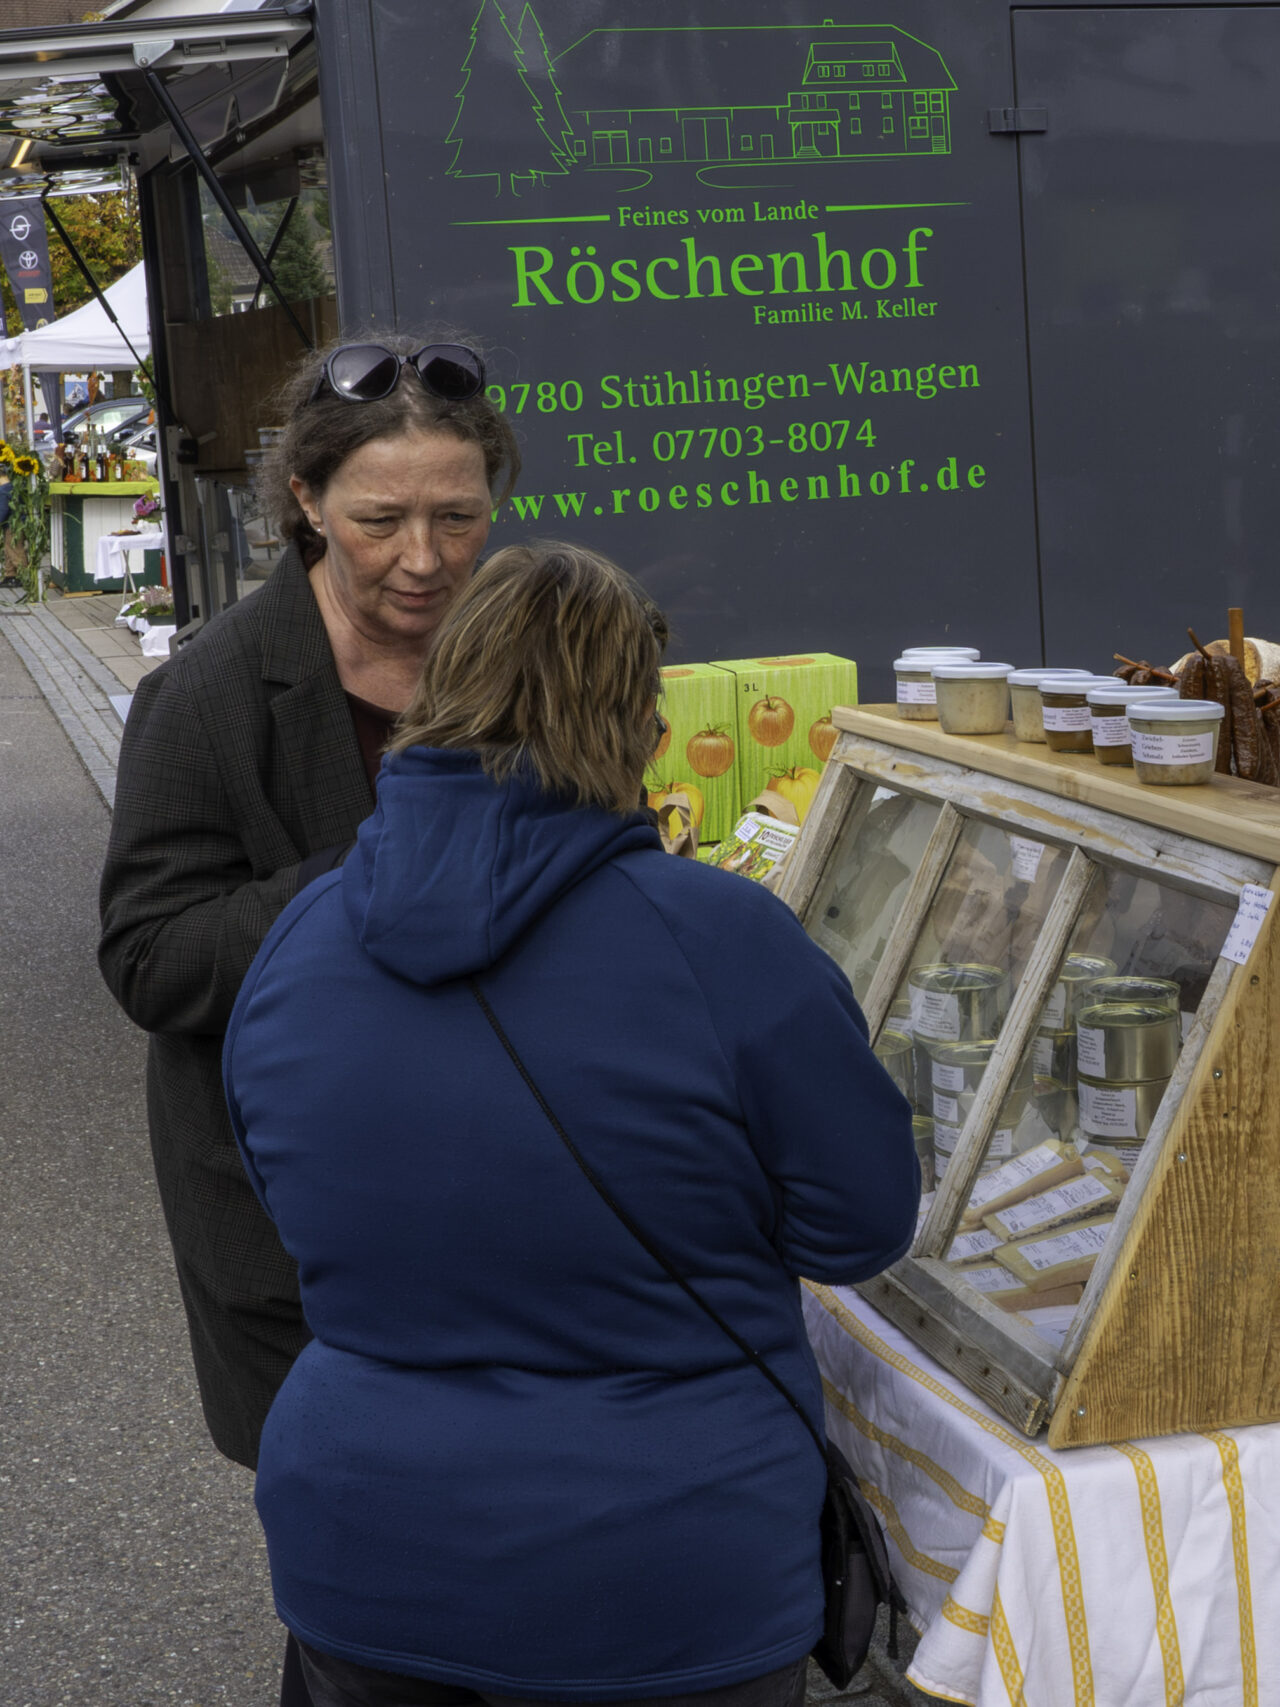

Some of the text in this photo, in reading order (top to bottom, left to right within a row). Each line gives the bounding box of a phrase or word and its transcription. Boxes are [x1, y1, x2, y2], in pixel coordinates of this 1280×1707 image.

[617, 199, 820, 227] Feines vom Lande
[507, 226, 935, 308] Röschenhof
[752, 296, 939, 326] Familie M. Keller
[599, 361, 982, 412] Stühlingen-Wangen
[567, 417, 878, 468] Tel. 07703-8074
[743, 682, 760, 693] 3 L
